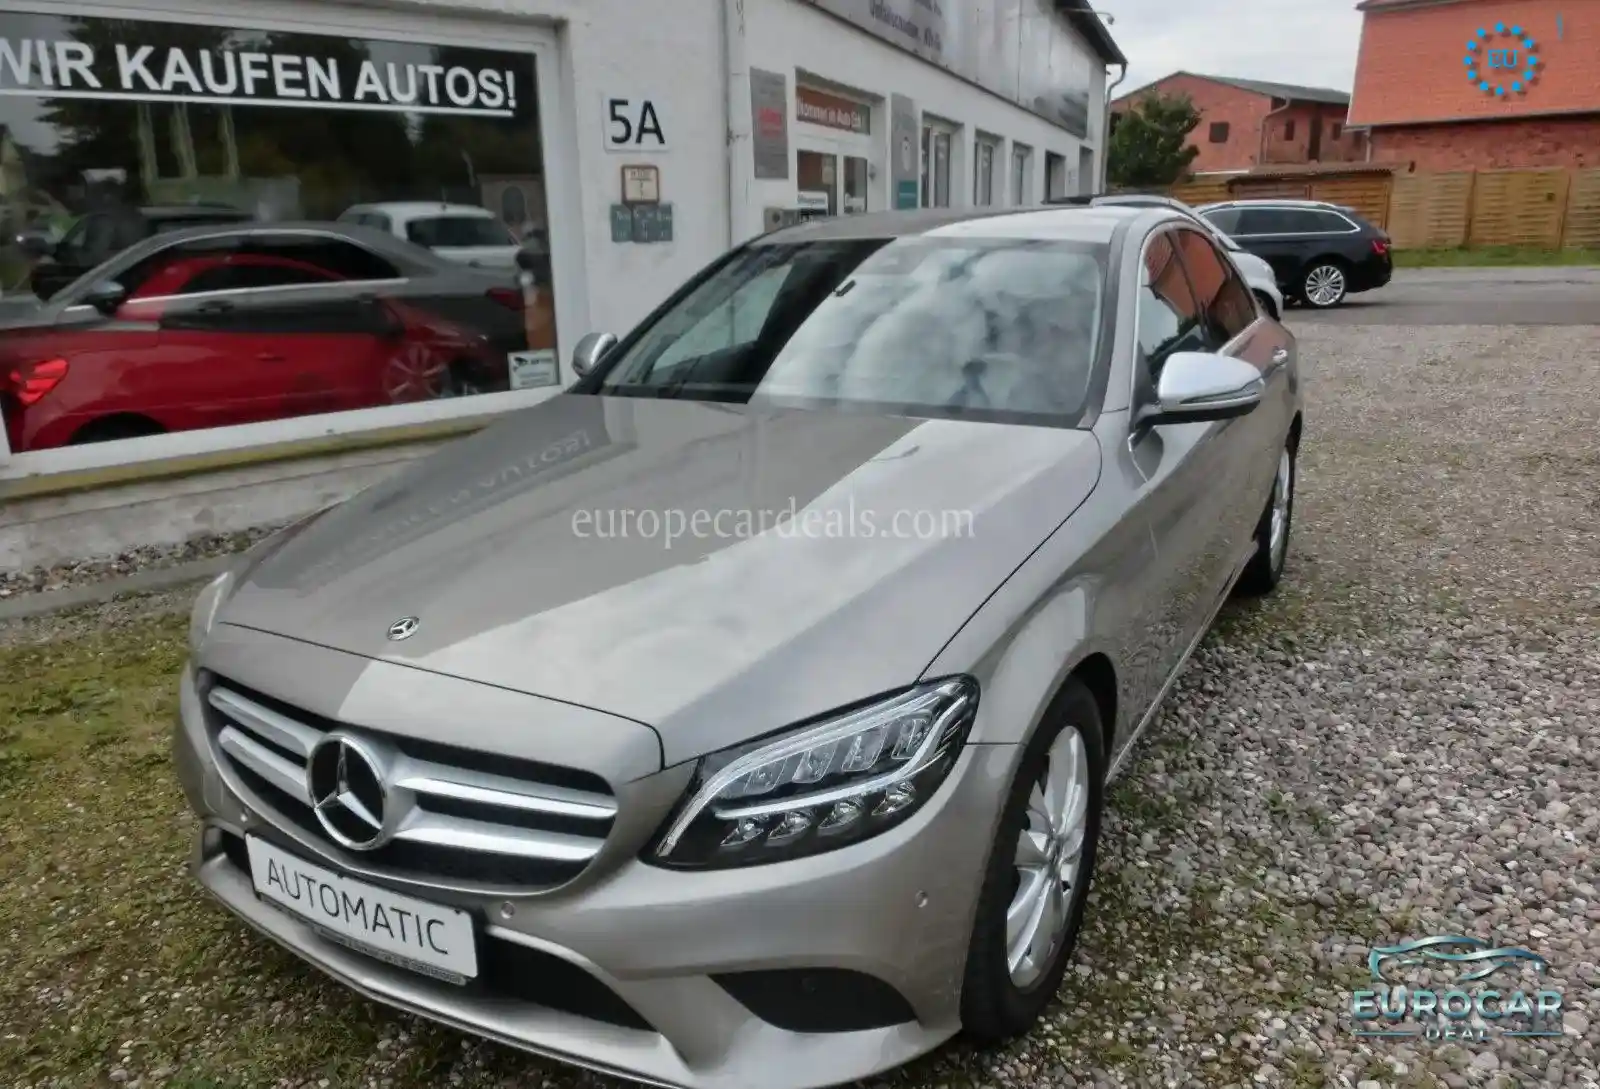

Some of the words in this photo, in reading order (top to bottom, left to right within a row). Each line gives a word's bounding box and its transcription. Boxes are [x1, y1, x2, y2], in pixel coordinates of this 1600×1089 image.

[115, 44, 341, 98] KAUFEN
[354, 60, 516, 108] AUTOS!
[609, 98, 665, 144] 5A
[268, 858, 448, 955] AUTOMATIC
